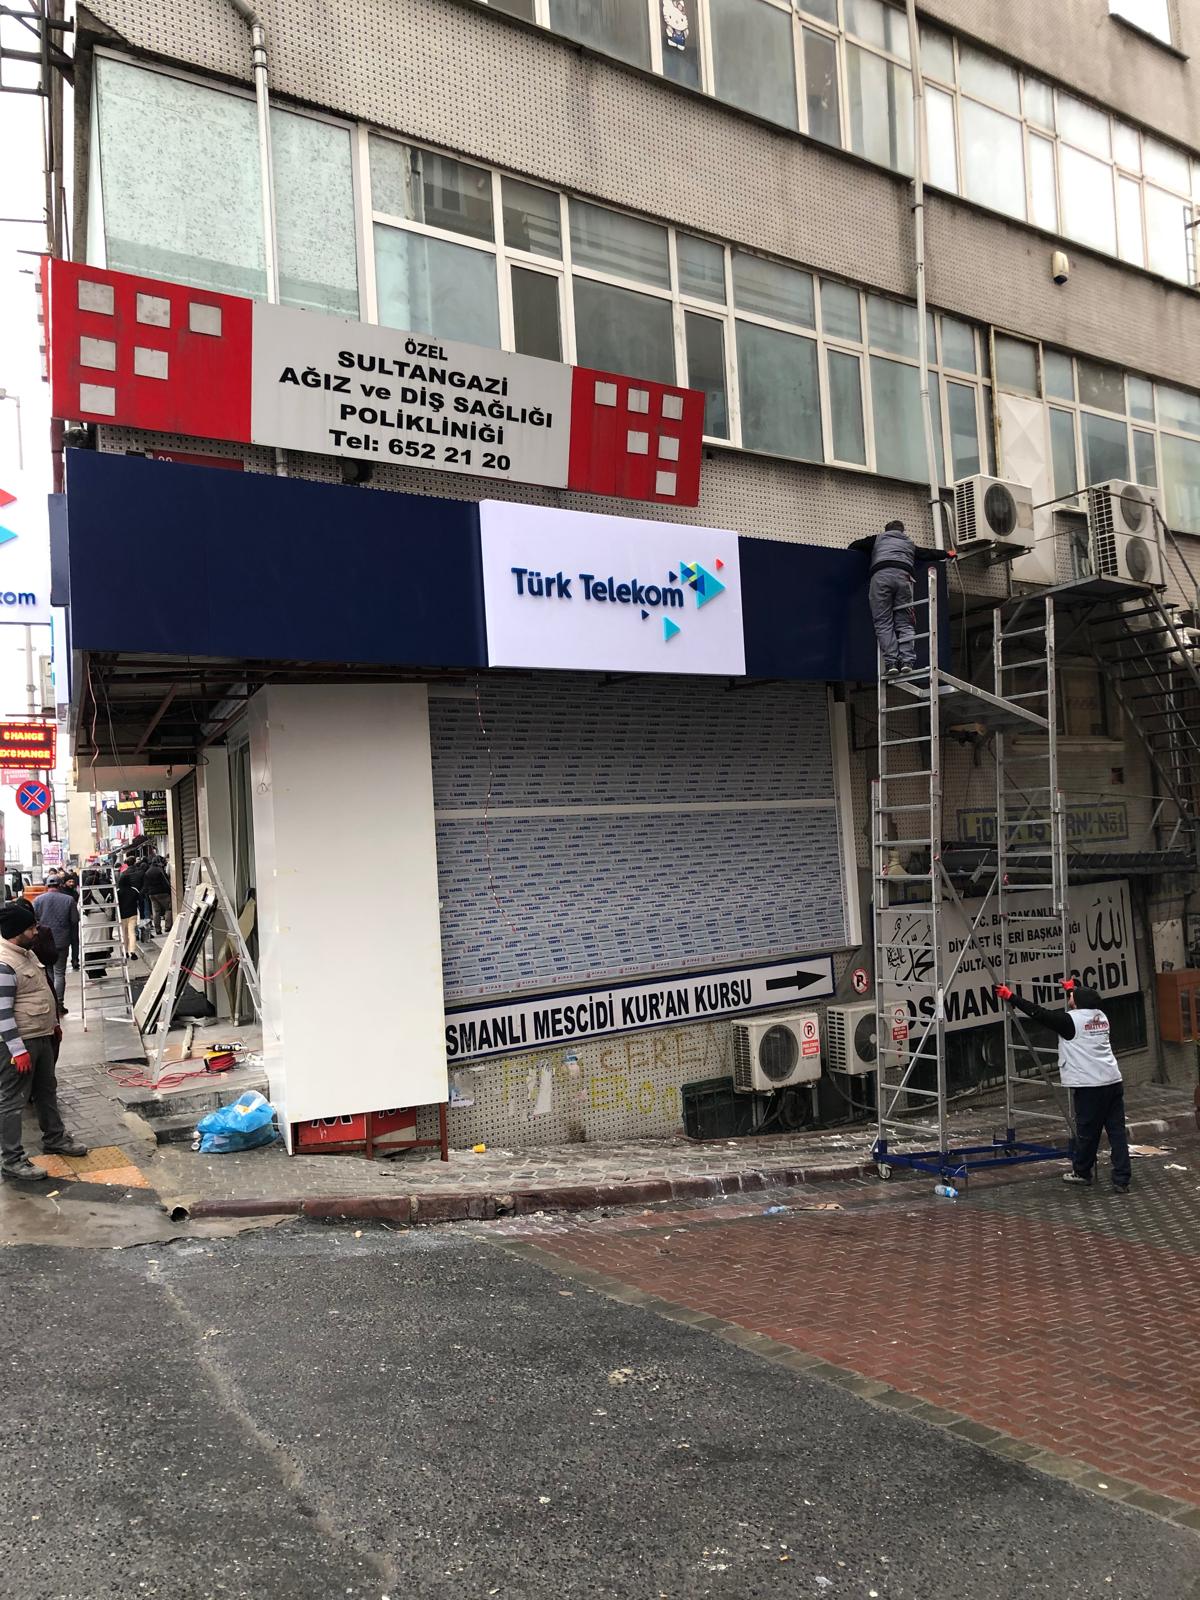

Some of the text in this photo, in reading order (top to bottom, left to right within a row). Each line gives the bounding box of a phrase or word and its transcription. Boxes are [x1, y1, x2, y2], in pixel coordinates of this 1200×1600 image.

[404, 338, 448, 361] ÖZEL
[338, 351, 508, 396] SULTANGAZİ
[279, 366, 552, 428] AĞIZ ve DİŞ SAĞLIĞI
[340, 404, 504, 445] POLİKLİNİĞİ
[329, 429, 511, 471] Tel: 652 21 20
[511, 567, 684, 607] Türk Telekom
[533, 992, 615, 1040] MESCİDİ
[622, 987, 690, 1025] KUR'AN
[694, 978, 752, 1013] KURSU
